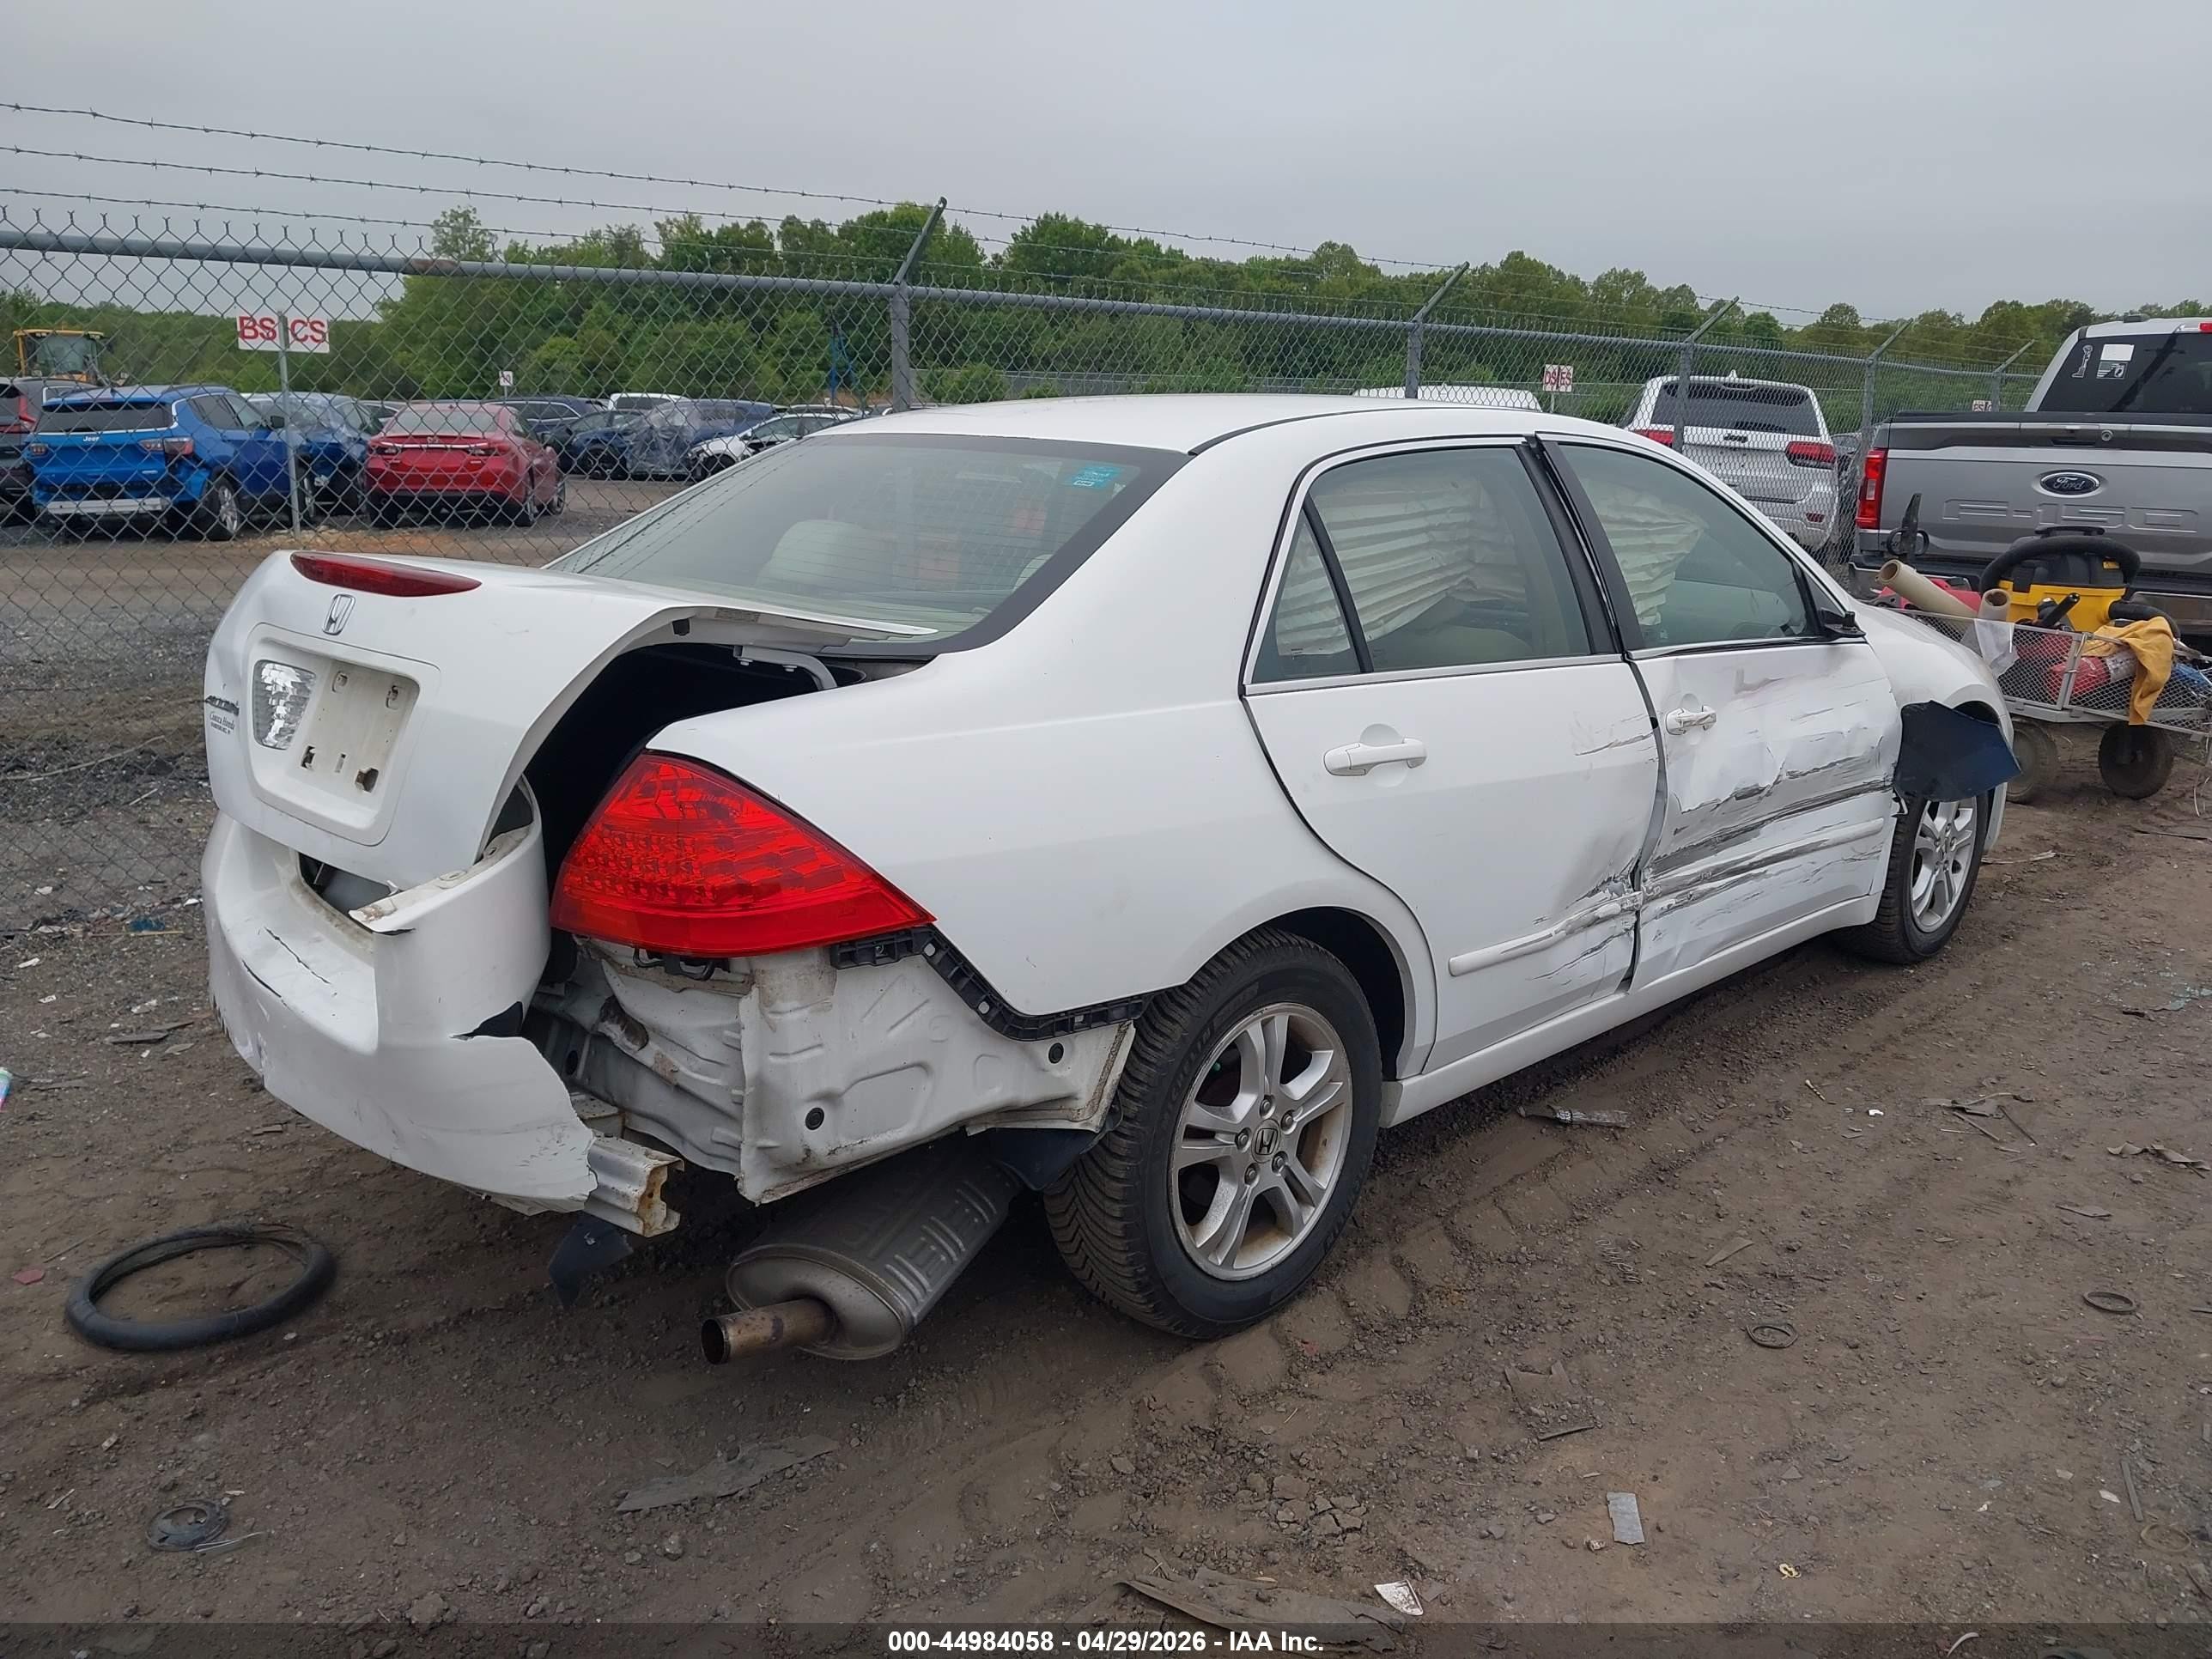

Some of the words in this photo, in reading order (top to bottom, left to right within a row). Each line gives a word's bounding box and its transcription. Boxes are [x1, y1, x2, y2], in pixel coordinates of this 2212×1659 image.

[239, 316, 277, 341] BS
[290, 319, 326, 343] CS
[1560, 371, 1571, 386] ES
[2053, 477, 2086, 490] Ford
[1942, 498, 2199, 533] F-150
